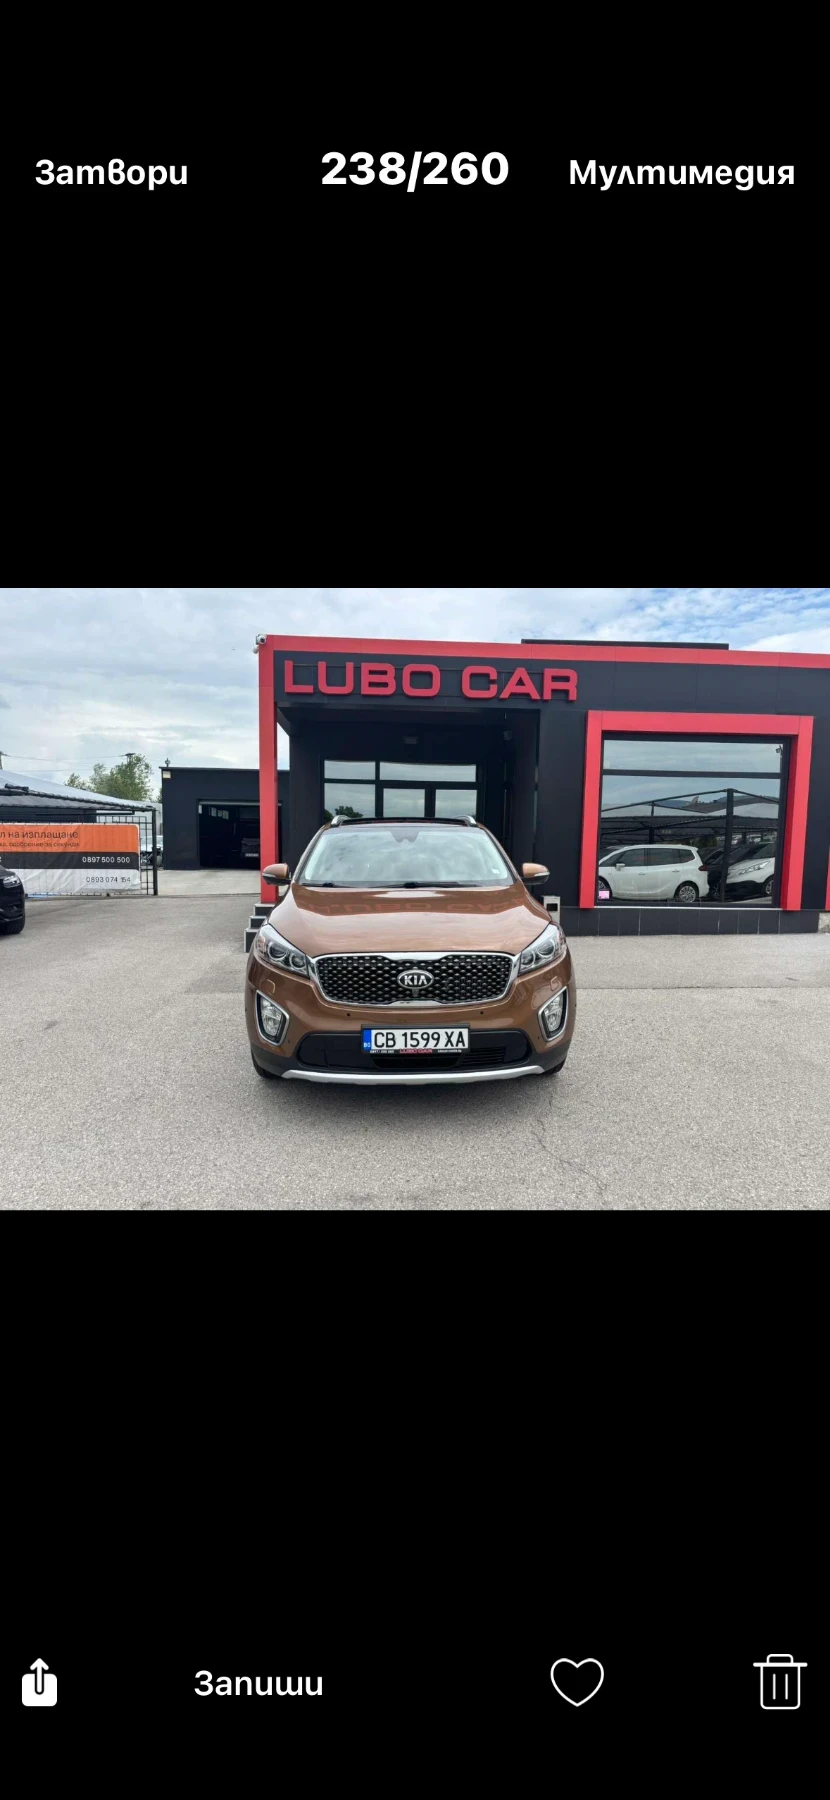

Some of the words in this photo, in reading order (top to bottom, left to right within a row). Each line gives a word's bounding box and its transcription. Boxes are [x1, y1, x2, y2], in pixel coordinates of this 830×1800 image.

[284, 660, 441, 698] LUBO
[461, 665, 578, 701] CAR
[8, 831, 20, 839] на
[22, 831, 79, 839] изплащане
[404, 975, 428, 985] KIA
[374, 1031, 396, 1048] CB
[402, 1031, 441, 1048] 1599
[444, 1031, 466, 1048] XA
